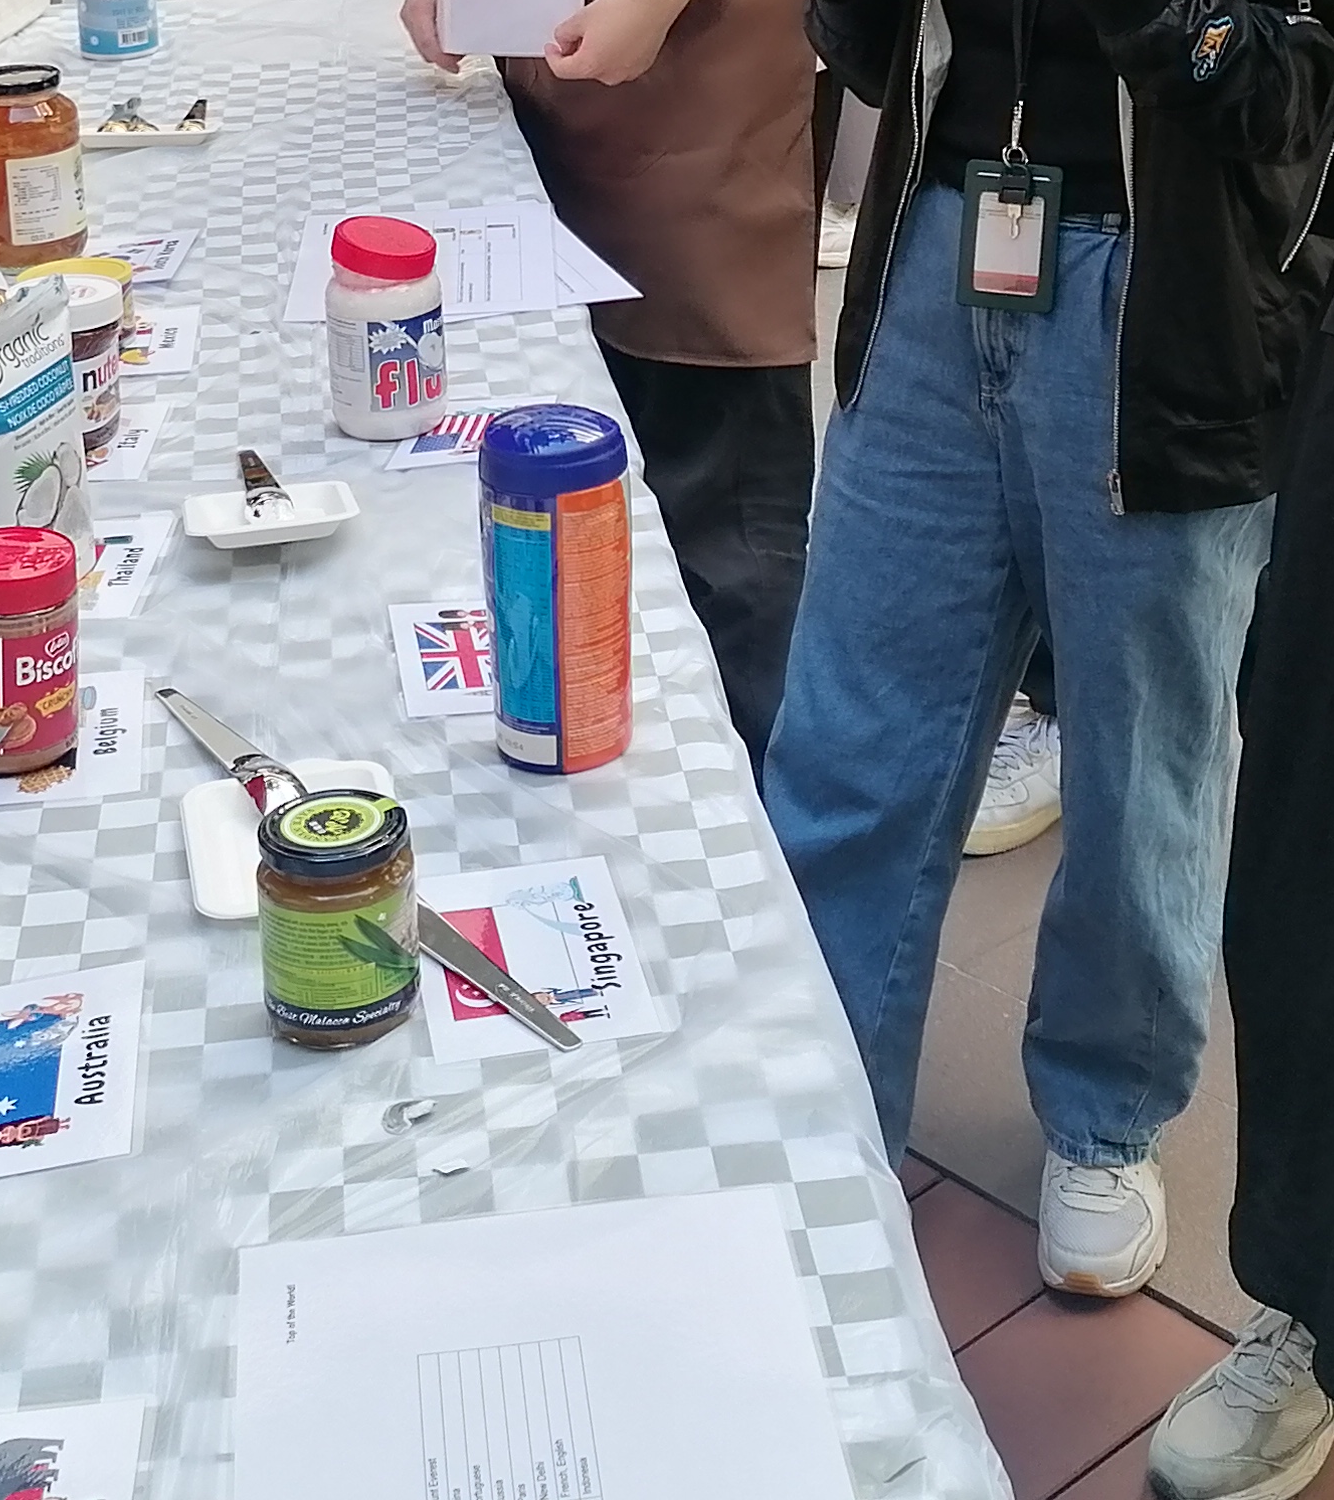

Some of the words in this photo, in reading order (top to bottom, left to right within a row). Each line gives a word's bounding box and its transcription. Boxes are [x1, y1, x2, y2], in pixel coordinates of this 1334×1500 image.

[117, 428, 149, 449] Italy
[107, 547, 144, 587] Thailand
[93, 707, 127, 756] Belgium
[573, 902, 622, 990] Singapore
[352, 999, 403, 1025] Specialty
[74, 1015, 111, 1104] Australia
[555, 1438, 567, 1467] English
[428, 1458, 439, 1488] Everest
[536, 1461, 546, 1483] Delhi
[580, 1457, 592, 1496] Indonesia
